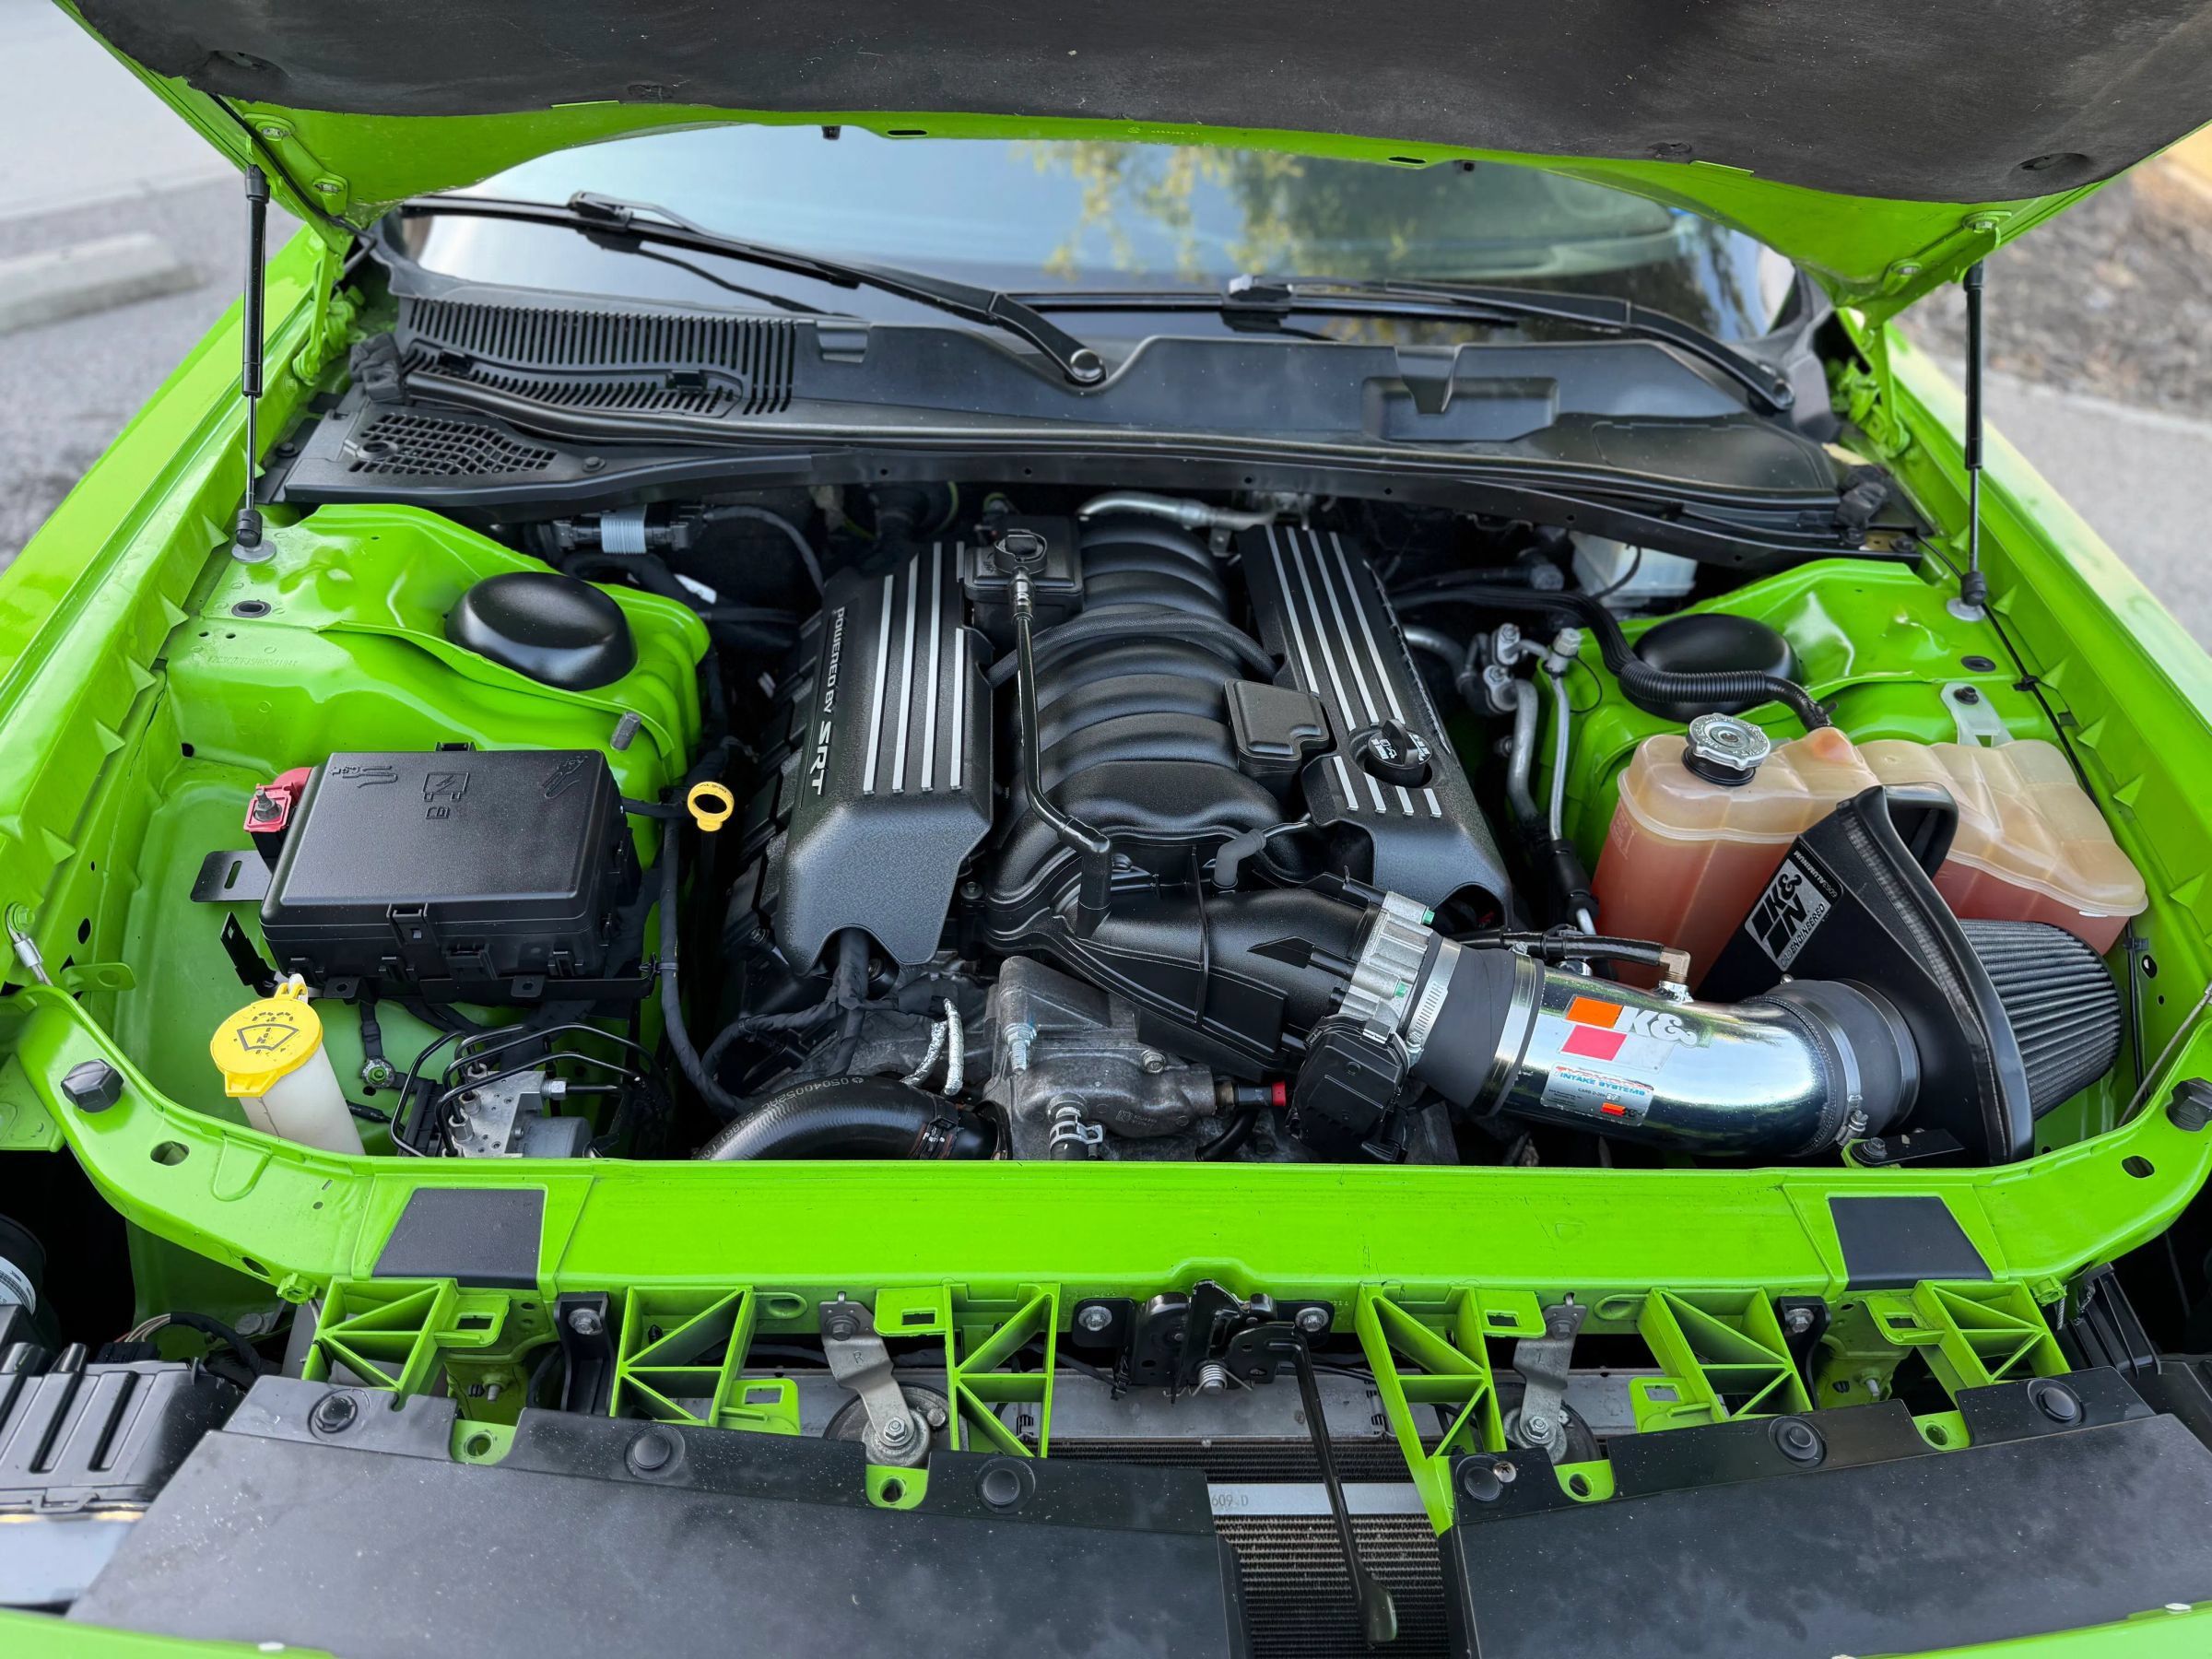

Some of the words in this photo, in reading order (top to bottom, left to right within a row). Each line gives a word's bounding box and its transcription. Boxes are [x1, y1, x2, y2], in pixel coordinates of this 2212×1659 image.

[828, 606, 845, 688] POWERED
[824, 689, 834, 713] BY
[810, 721, 831, 795] SRT
[1764, 873, 1807, 937] K&N
[1559, 1072, 1596, 1085] INTAKE
[1598, 1081, 1645, 1096] SYSTEMS
[853, 1350, 864, 1364] R
